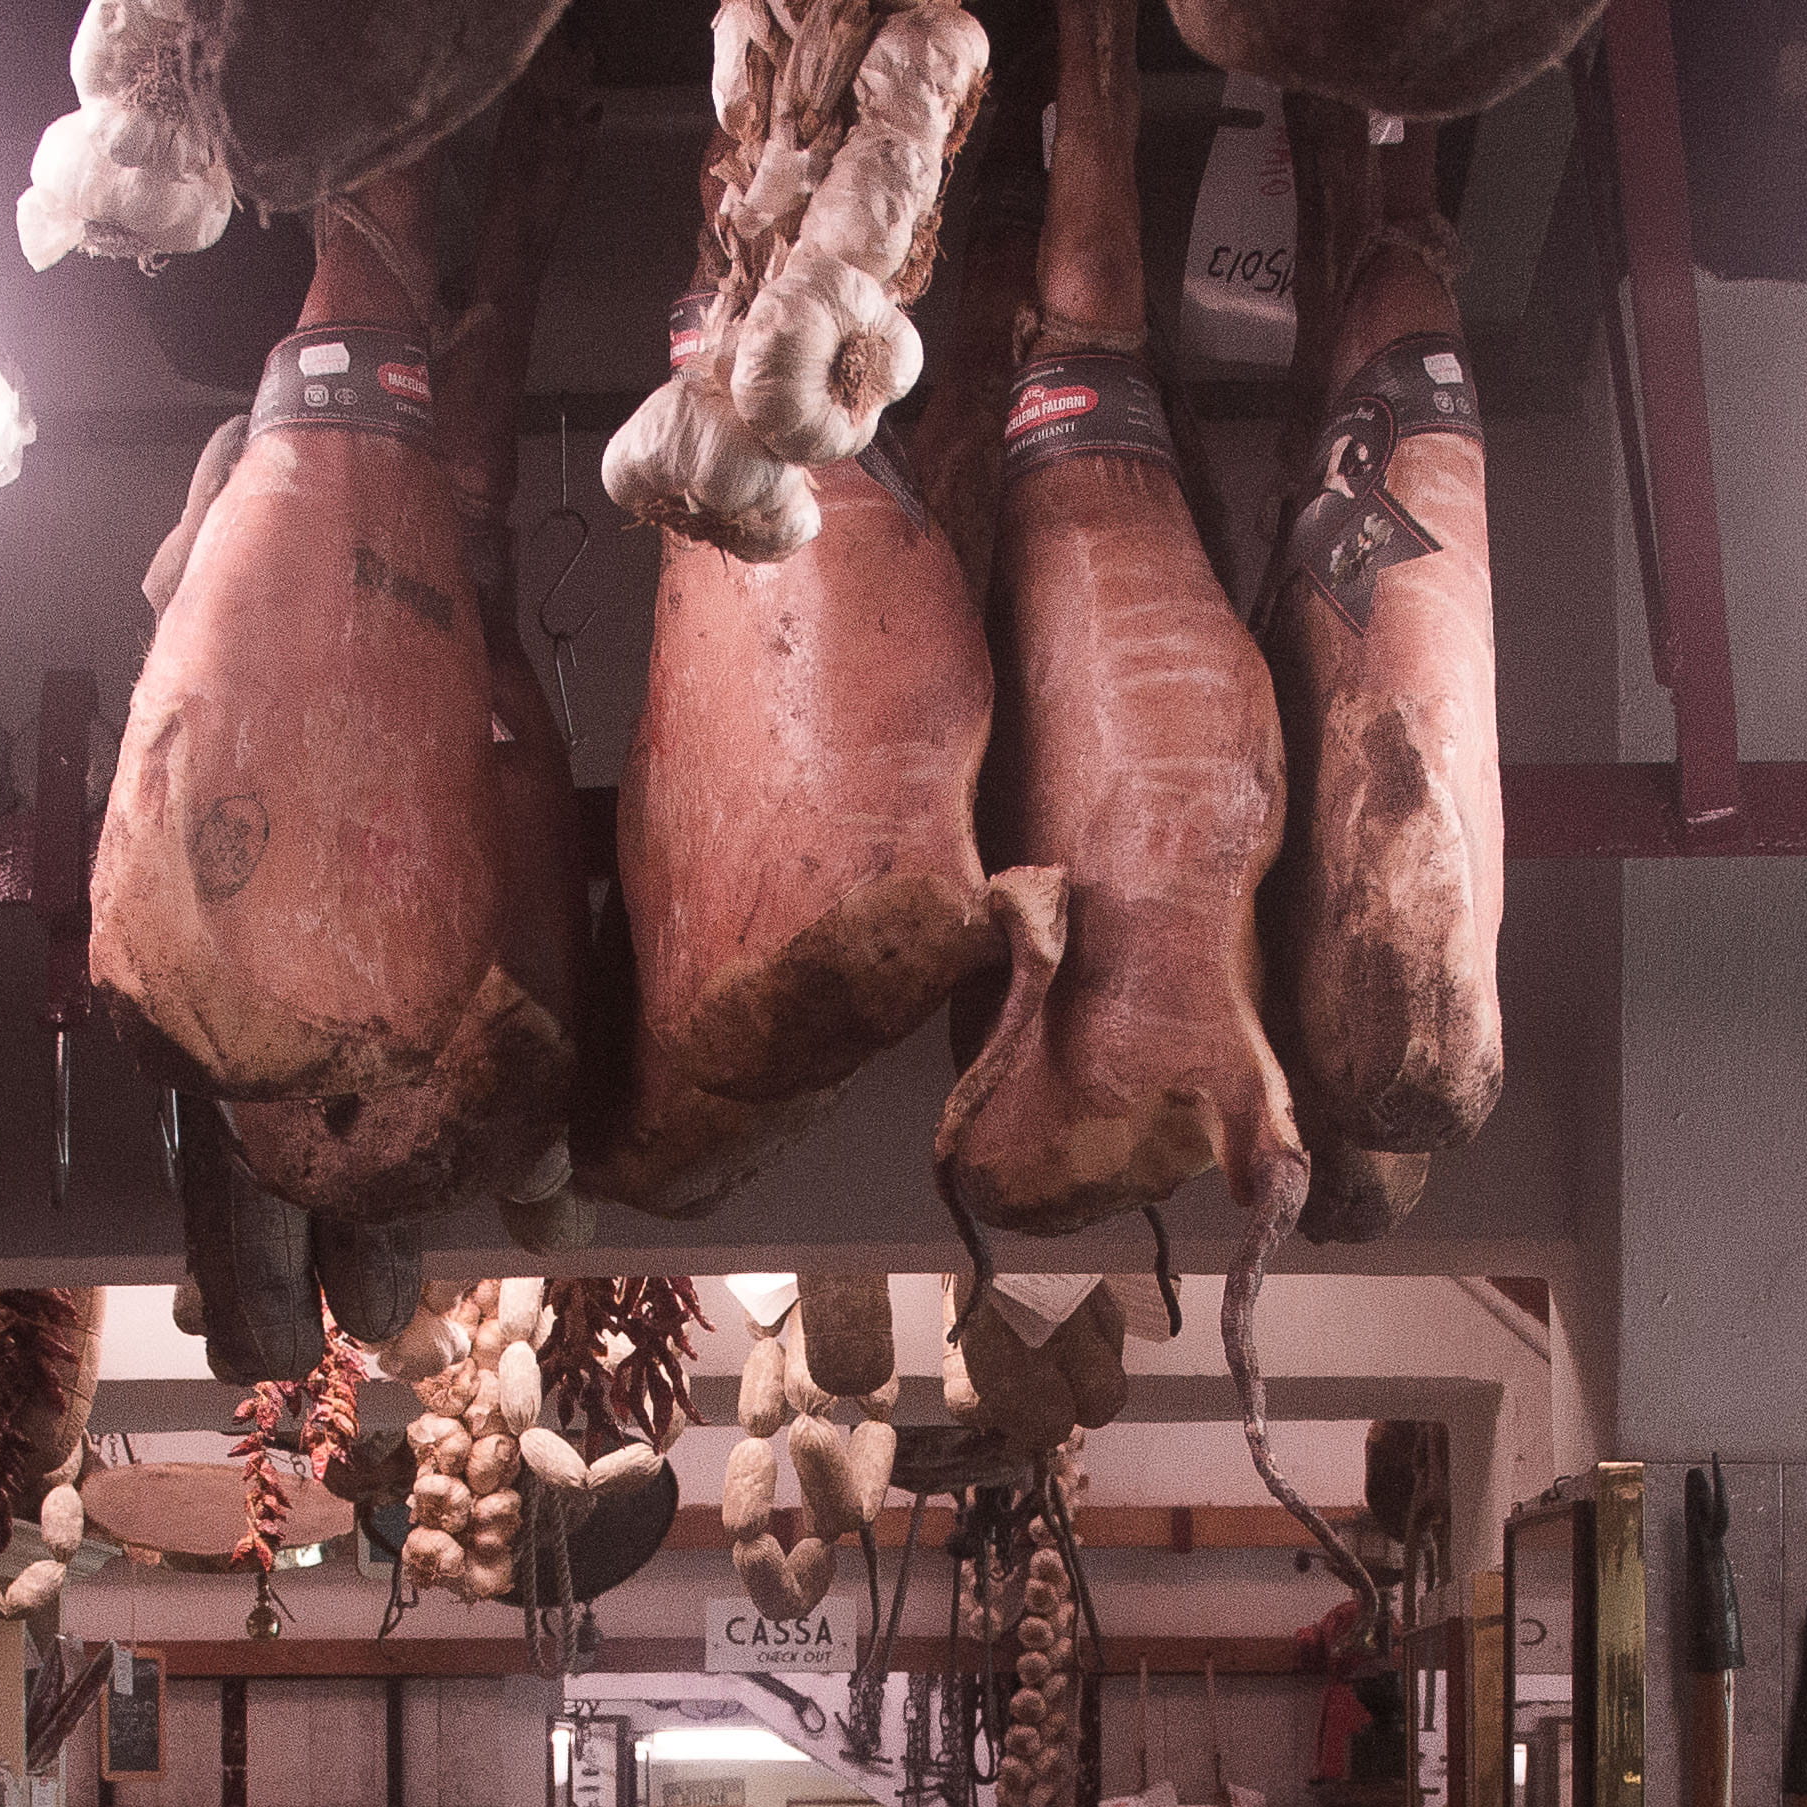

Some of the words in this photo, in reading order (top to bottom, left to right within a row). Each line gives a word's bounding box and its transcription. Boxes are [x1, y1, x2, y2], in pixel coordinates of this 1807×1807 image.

[725, 1615, 834, 1647] CASSA
[757, 1650, 798, 1664] CHECK
[804, 1650, 833, 1664] OUT
